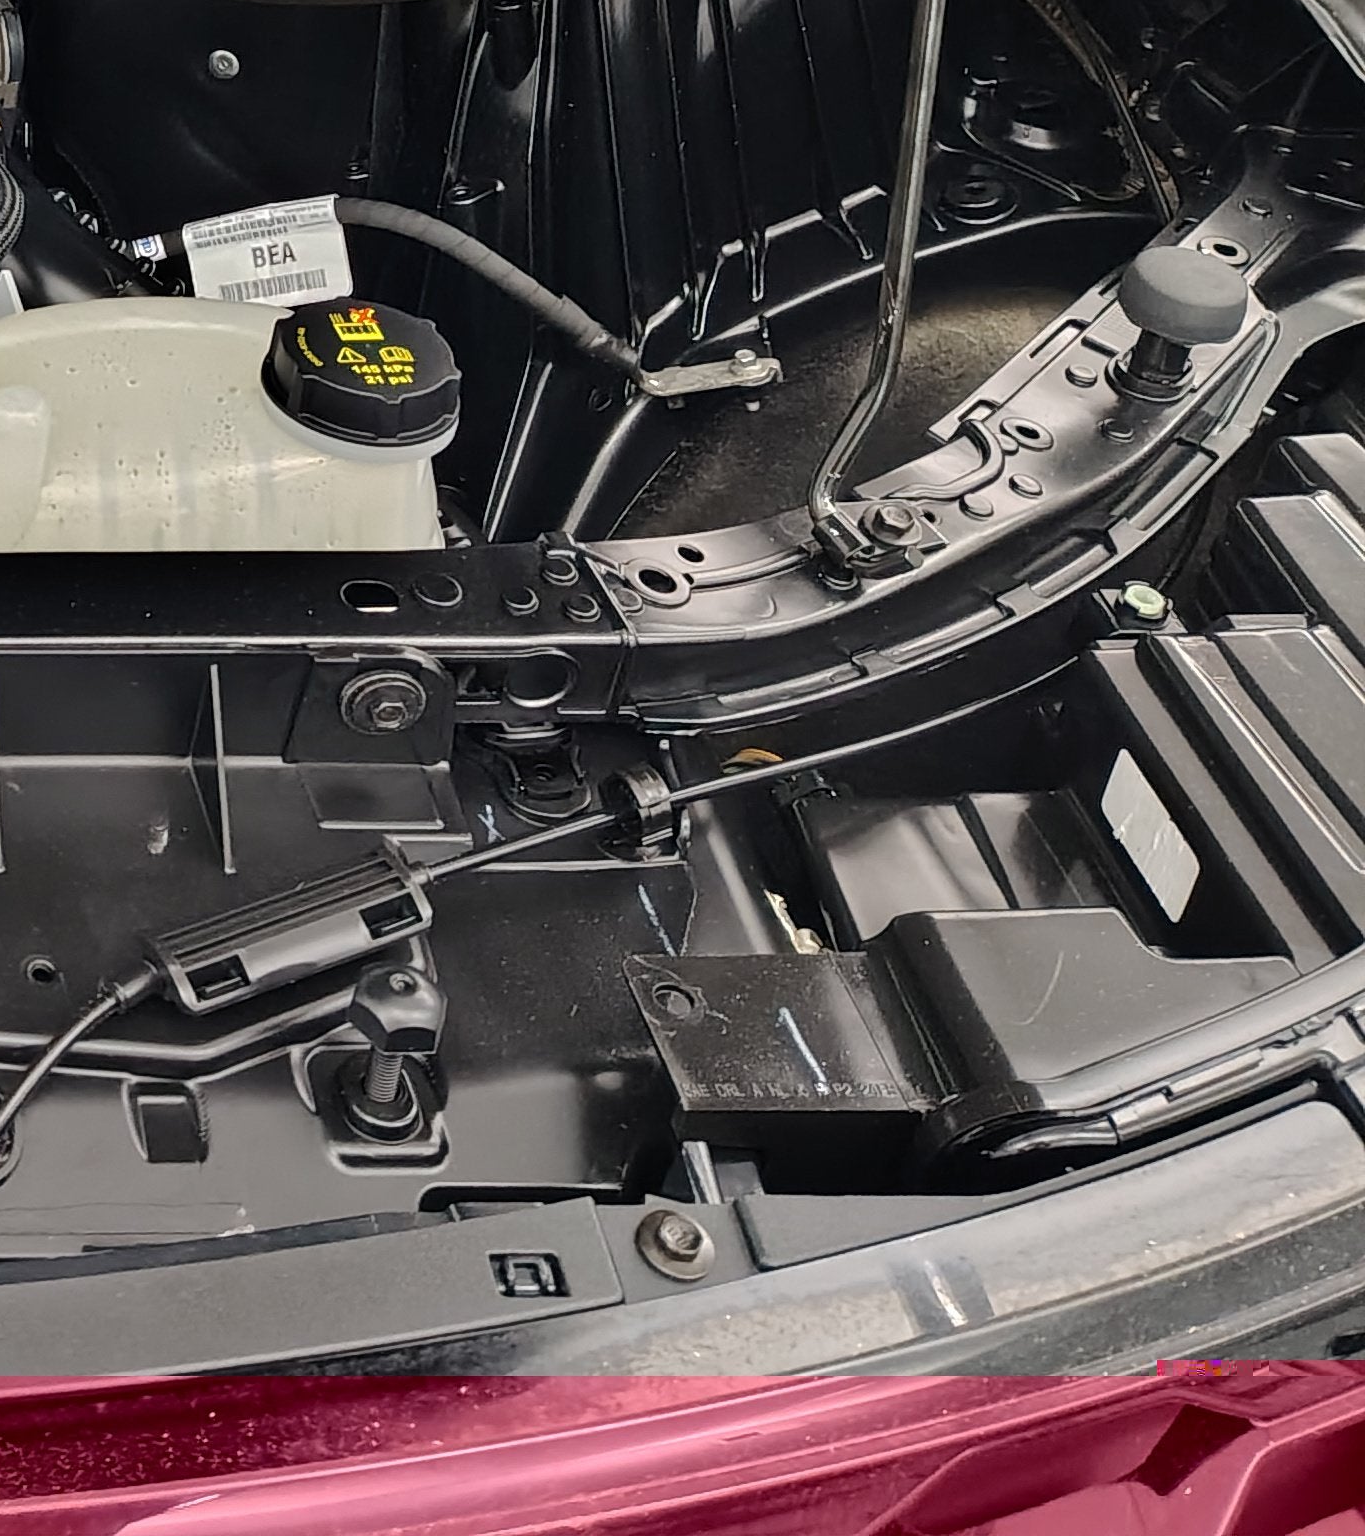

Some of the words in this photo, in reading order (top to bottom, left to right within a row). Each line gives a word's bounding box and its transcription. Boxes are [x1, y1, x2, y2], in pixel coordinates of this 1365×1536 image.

[251, 241, 297, 268] BEA
[383, 364, 414, 373] kPa
[364, 375, 384, 384] 21
[388, 374, 413, 385] psi
